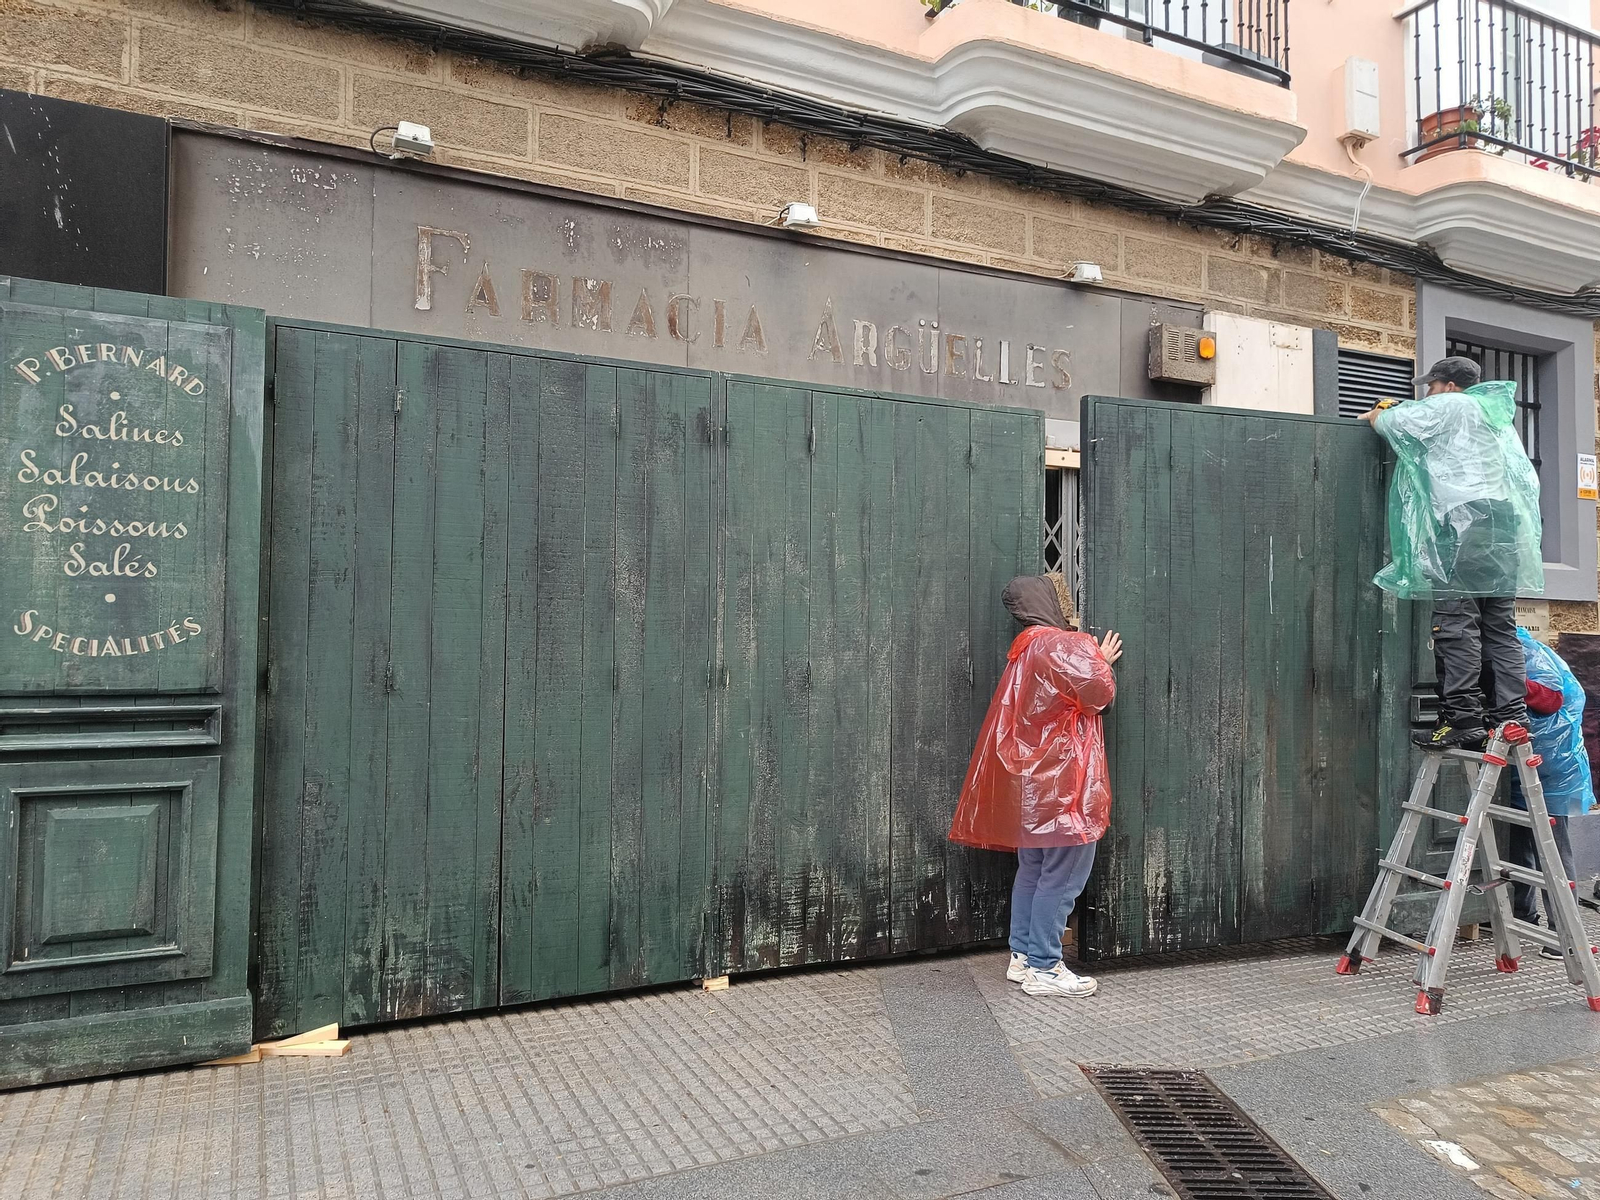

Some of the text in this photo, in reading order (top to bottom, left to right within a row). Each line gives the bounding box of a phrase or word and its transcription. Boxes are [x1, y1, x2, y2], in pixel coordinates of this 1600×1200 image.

[414, 225, 1073, 391] FARMACIA ARGÜELLES
[44, 343, 204, 396] BERNARD
[55, 403, 184, 447] Salines
[63, 542, 158, 578] Salés
[13, 609, 202, 657] SPECIALITÉS
